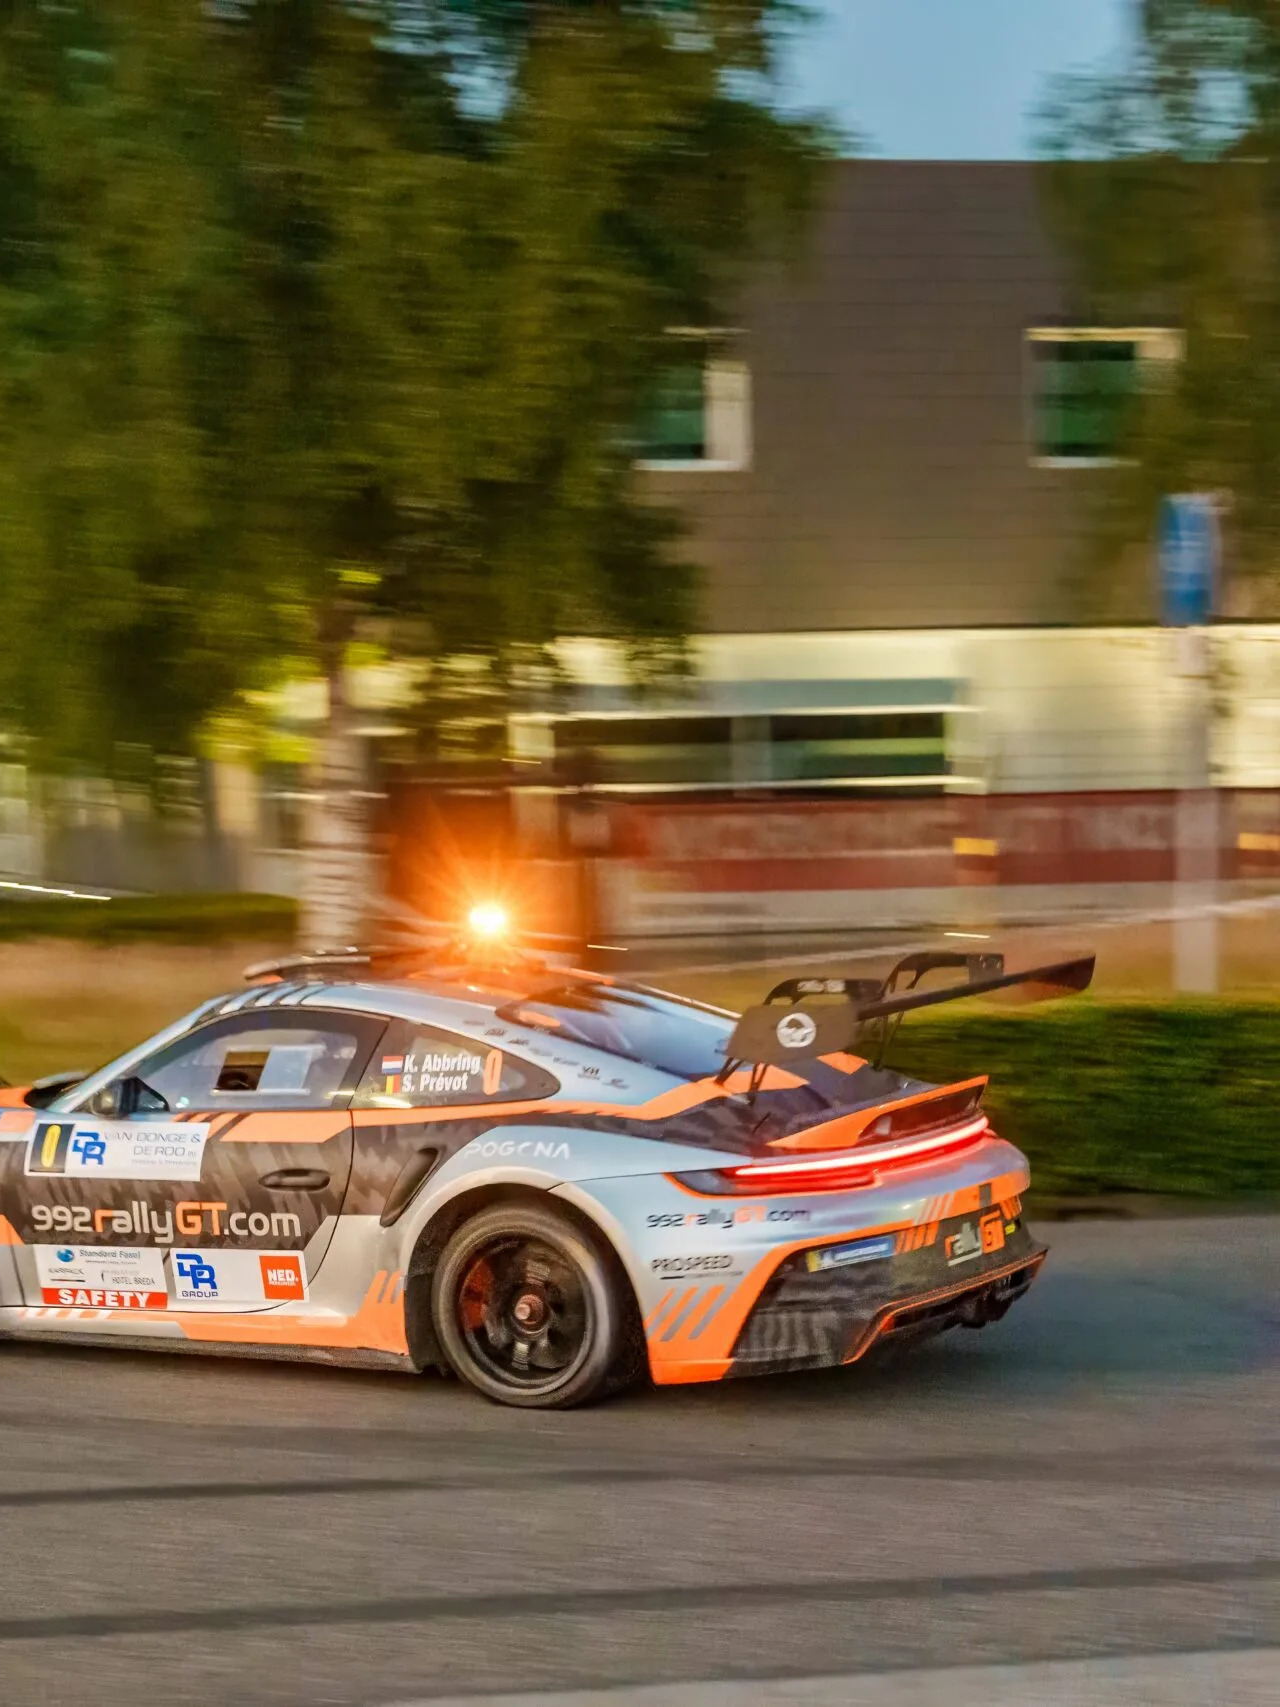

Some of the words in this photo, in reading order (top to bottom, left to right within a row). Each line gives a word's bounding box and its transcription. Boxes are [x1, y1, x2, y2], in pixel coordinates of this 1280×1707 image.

[403, 1054, 418, 1073] K.
[421, 1053, 481, 1075] Abbring
[402, 1073, 416, 1093] S.
[31, 1200, 302, 1244] 992rallyGT.com
[58, 1288, 151, 1309] SAFETY
